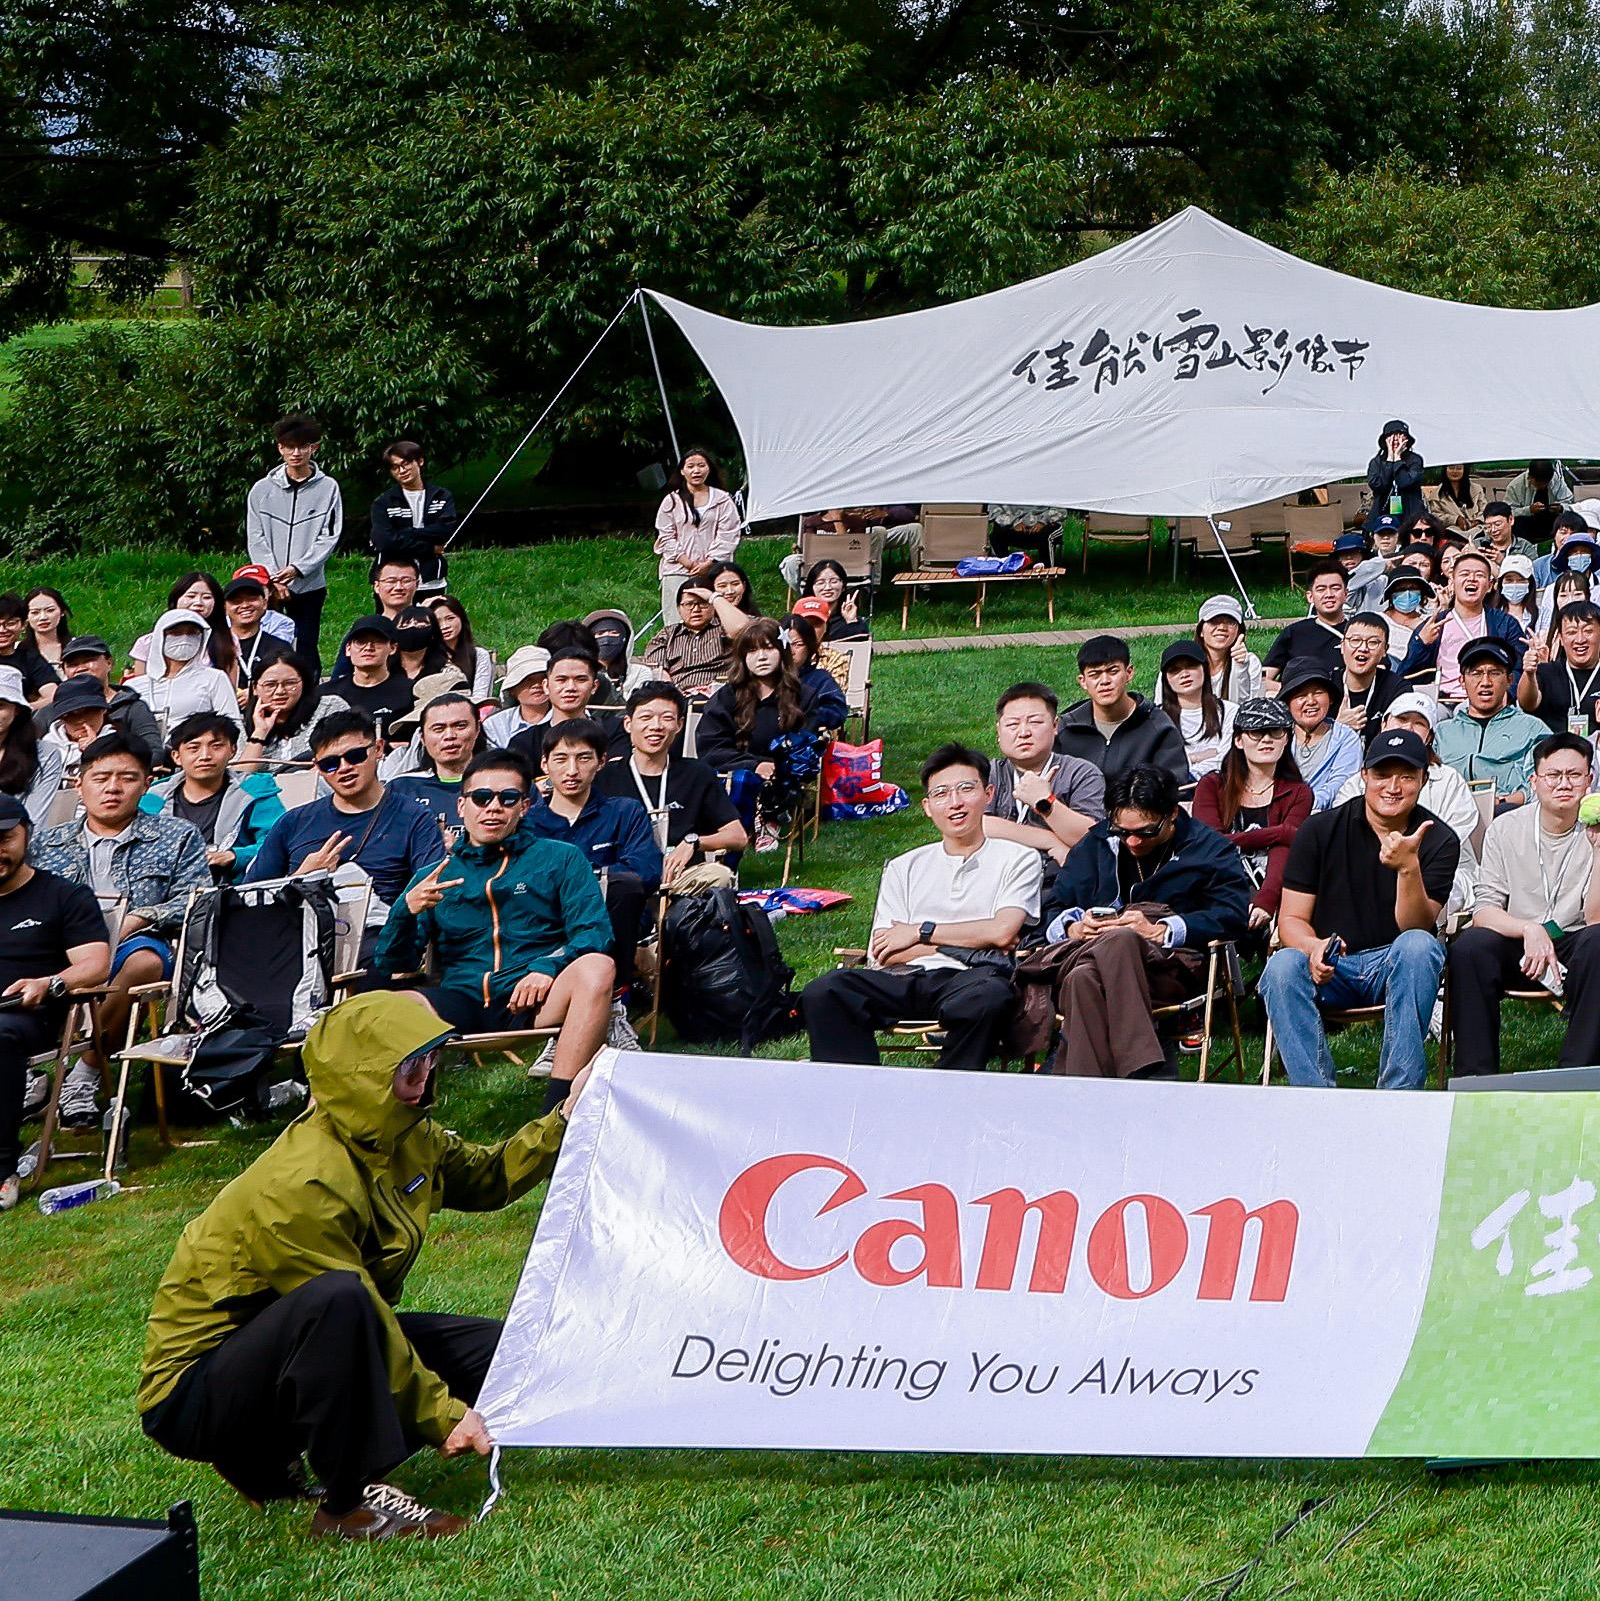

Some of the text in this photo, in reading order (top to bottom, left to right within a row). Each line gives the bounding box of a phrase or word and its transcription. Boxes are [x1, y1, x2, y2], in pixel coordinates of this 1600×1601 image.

[1012, 308, 1370, 395] 佳能雪山影像节
[718, 1152, 1302, 1304] Canon
[671, 1334, 1259, 1403] Delighting You Always
